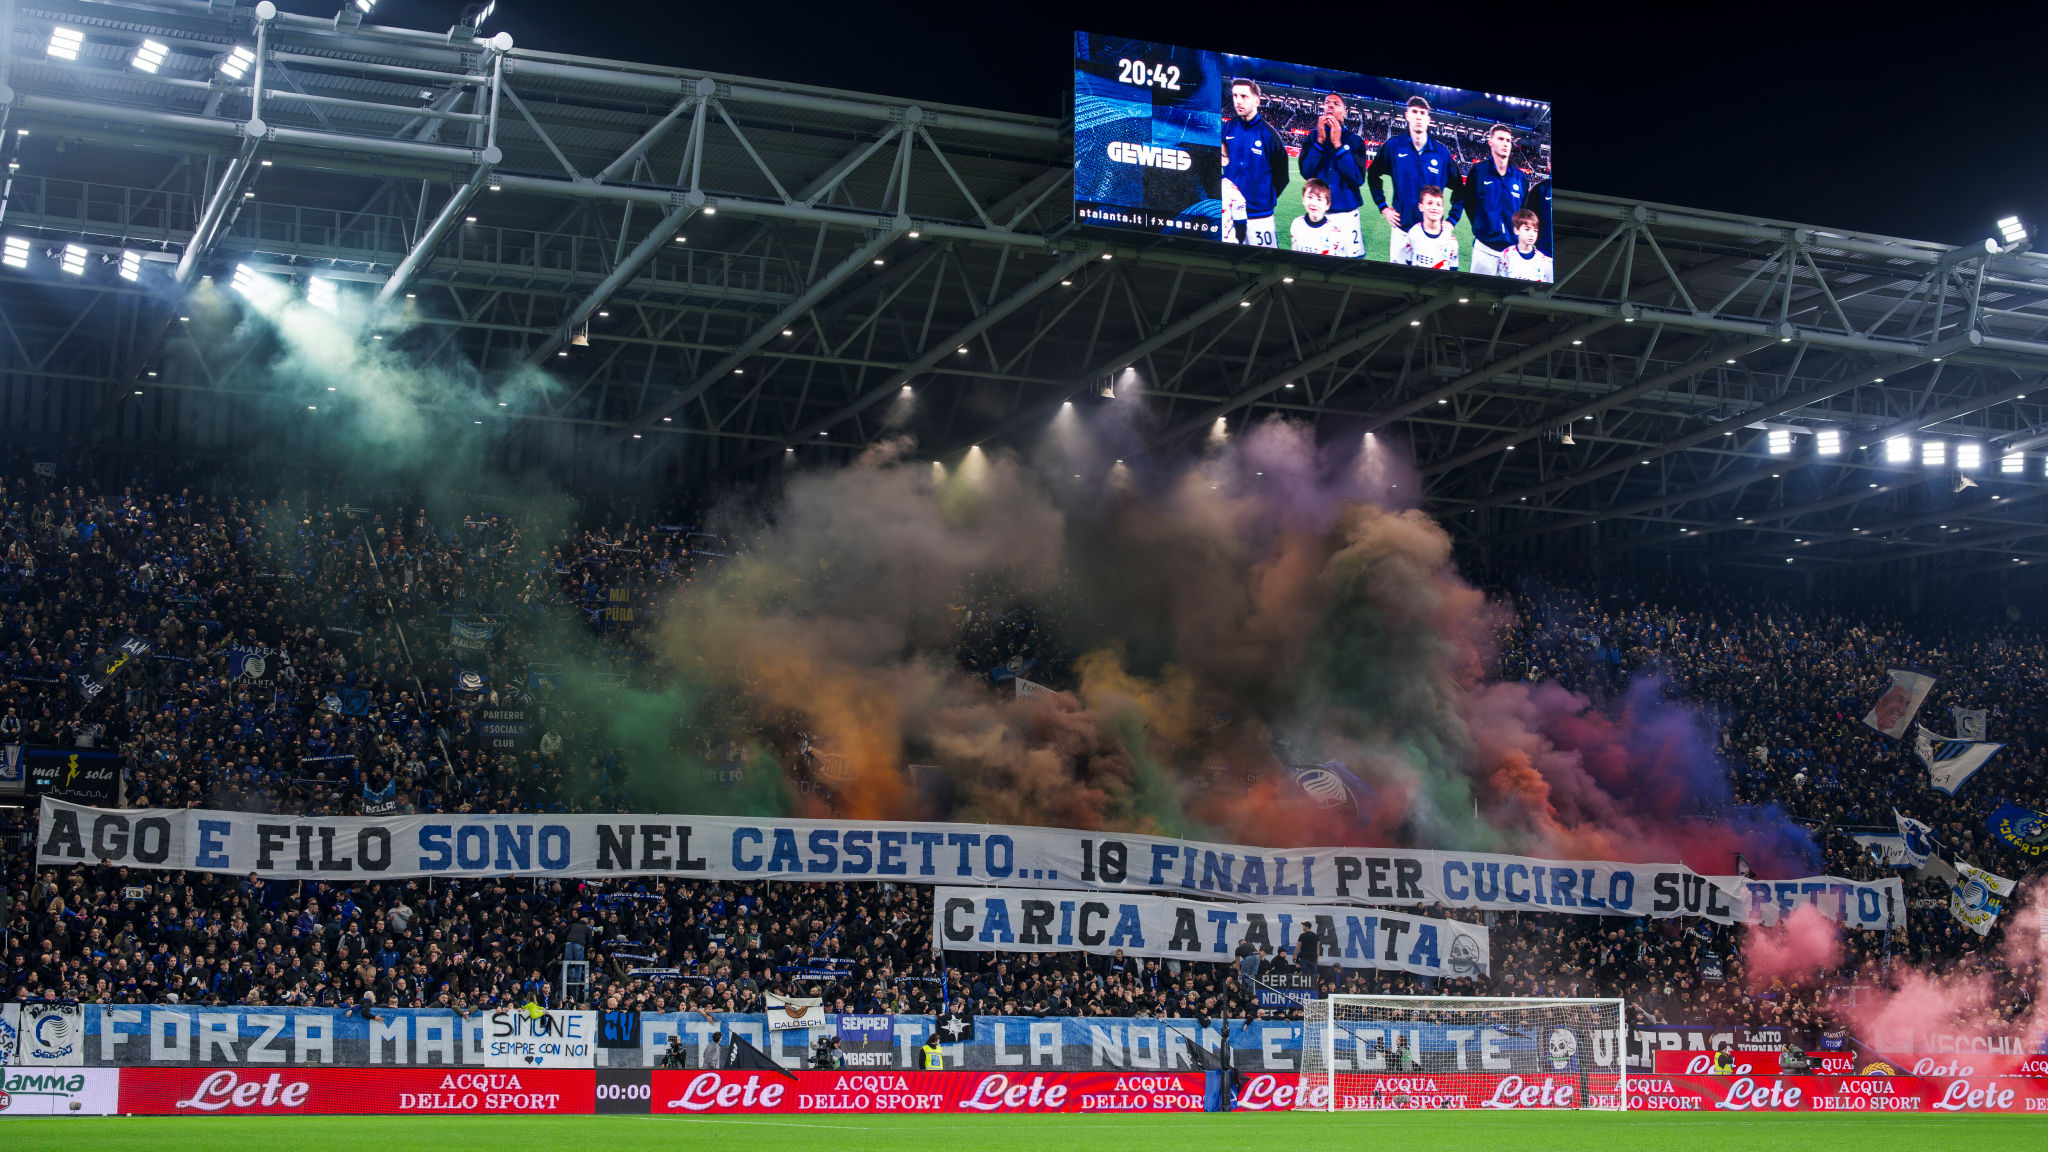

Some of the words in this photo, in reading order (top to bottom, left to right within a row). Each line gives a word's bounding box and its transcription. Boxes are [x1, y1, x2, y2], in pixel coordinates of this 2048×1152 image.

[1118, 58, 1181, 91] 20:42
[1107, 141, 1192, 171] GEWISS
[1079, 208, 1143, 225] atalanta.it
[1255, 231, 1272, 245] 30
[1352, 230, 1359, 244] 2
[609, 587, 630, 602] MAI
[483, 710, 525, 720] PARTERRE
[489, 725, 518, 734] SOCIAL
[493, 738, 515, 748] CLUB
[32, 766, 61, 777] mai
[85, 767, 114, 780] sola
[42, 809, 171, 865] AGO
[197, 819, 231, 869] E
[256, 824, 392, 871] FILO
[418, 823, 572, 872] SONO
[596, 824, 707, 871] NEL
[732, 827, 1058, 880] CASSETTO...
[1149, 844, 1316, 897] FINALI
[1334, 856, 1425, 898] PER
[1443, 860, 1635, 911] CUCIRLO
[1653, 872, 1731, 917] SUL
[1746, 883, 1896, 923] PETTO!
[943, 896, 1145, 948] CARICA
[1168, 905, 1441, 968] ATALANTA
[1262, 974, 1287, 987] PER
[1291, 974, 1312, 988] CHI
[1262, 992, 1286, 1005] NON
[492, 1012, 584, 1039] SIMONE
[101, 1009, 341, 1063] FORZA
[994, 1022, 1063, 1066] LA
[1446, 1029, 1511, 1071] TE
[1743, 1031, 1782, 1043] TANTO
[490, 1042, 535, 1056] SEMPRE
[538, 1043, 561, 1056] CON
[565, 1044, 588, 1057] NOI
[0, 1068, 84, 1092] amma
[440, 1074, 522, 1092] ACQUA
[833, 1075, 909, 1093] ACQUA
[1114, 1077, 1184, 1094] ACQUA
[1373, 1078, 1438, 1094] ACQUA
[1614, 1079, 1674, 1096] ACQUA
[1838, 1080, 1895, 1096] ACQUA
[176, 1069, 310, 1112] Lete
[596, 1084, 651, 1101] 00:00
[668, 1074, 785, 1112] Lete
[959, 1074, 1067, 1112] Lete
[1237, 1074, 1331, 1111] Lete
[1481, 1075, 1575, 1109] Lete
[1715, 1077, 1801, 1110] Lete
[1933, 1079, 2015, 1111] Lete
[399, 1093, 479, 1110] DELLO
[486, 1093, 560, 1110] SPORT
[799, 1094, 871, 1110] DELLO
[876, 1094, 943, 1110] SPORT
[1081, 1094, 1149, 1110] DELLO
[1153, 1094, 1204, 1110] SPOR
[1410, 1094, 1468, 1110] SPORT
[1588, 1096, 1644, 1111] DELLO
[1647, 1096, 1702, 1111] SPORT
[1812, 1096, 1864, 1111] DELLO
[1868, 1096, 1921, 1111] SPORT
[2025, 1097, 2048, 1111] DE
